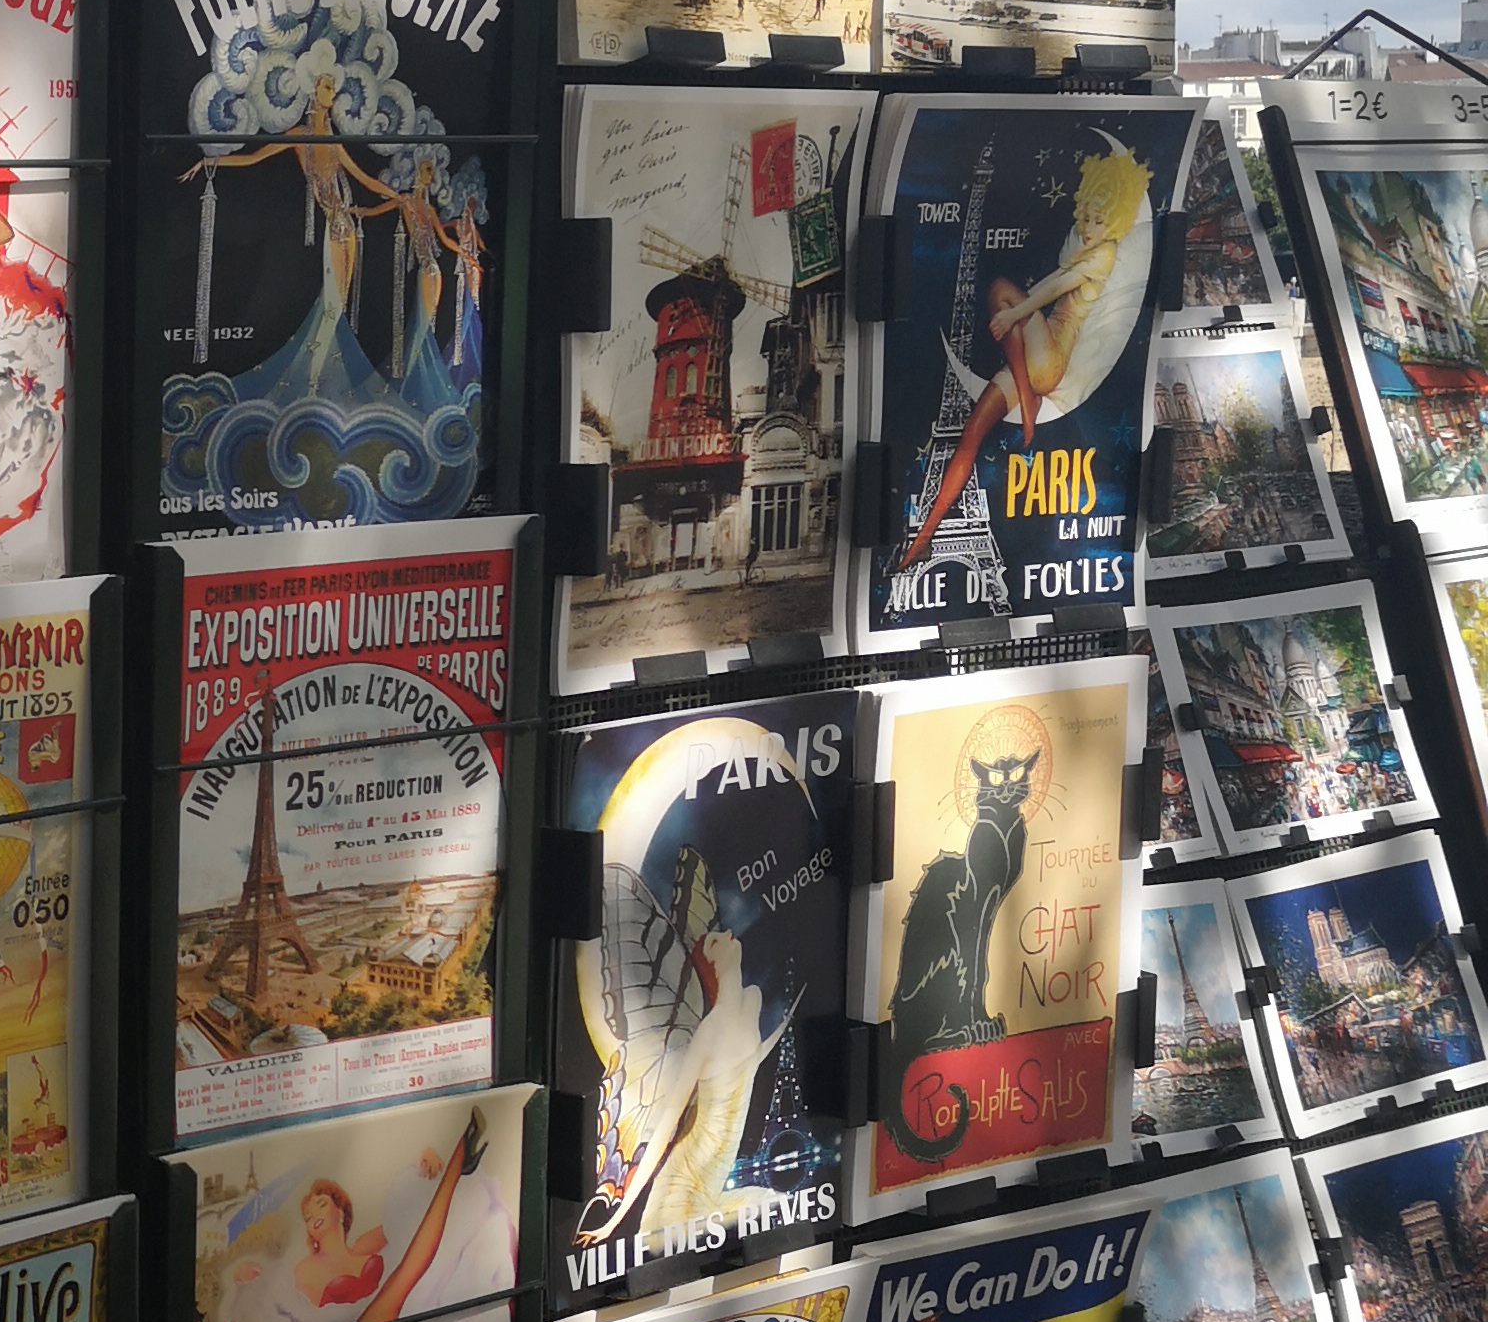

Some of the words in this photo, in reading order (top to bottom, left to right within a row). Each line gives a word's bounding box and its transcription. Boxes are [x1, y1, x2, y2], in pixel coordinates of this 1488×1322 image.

[1327, 90, 1388, 121] 1=2€
[917, 202, 961, 224] TOWER
[985, 228, 1024, 249] EIFFEL
[213, 326, 254, 340] 1932
[198, 489, 225, 511] les
[231, 486, 279, 510] Soirs
[1006, 448, 1096, 518] PARIS
[1058, 517, 1078, 540] LA
[1087, 515, 1126, 538] NUIT
[283, 578, 306, 597] FER
[884, 572, 947, 613] VILLE
[966, 566, 1008, 604] DES
[1023, 556, 1125, 599] FOLIES
[187, 598, 342, 671] EXPOSITION
[348, 584, 506, 652] UNIVERSELLE
[417, 654, 433, 670] DE
[438, 648, 507, 713] PARIS
[22, 691, 73, 717] 1893
[184, 677, 242, 744] 1889
[186, 674, 337, 821] INAUGURATION
[342, 684, 361, 705] DE
[684, 723, 842, 801] PARIS
[384, 828, 444, 844] PARIS
[736, 849, 778, 892] Bon
[762, 847, 833, 913] Voyage
[1018, 904, 1101, 963] CHAT
[1018, 961, 1107, 1009] NOIR
[1063, 1028, 1104, 1049] AVEC
[664, 1212, 726, 1257] DES
[945, 1260, 1018, 1316] Can
[1022, 1244, 1075, 1299] Do
[1083, 1228, 1136, 1284] It!
